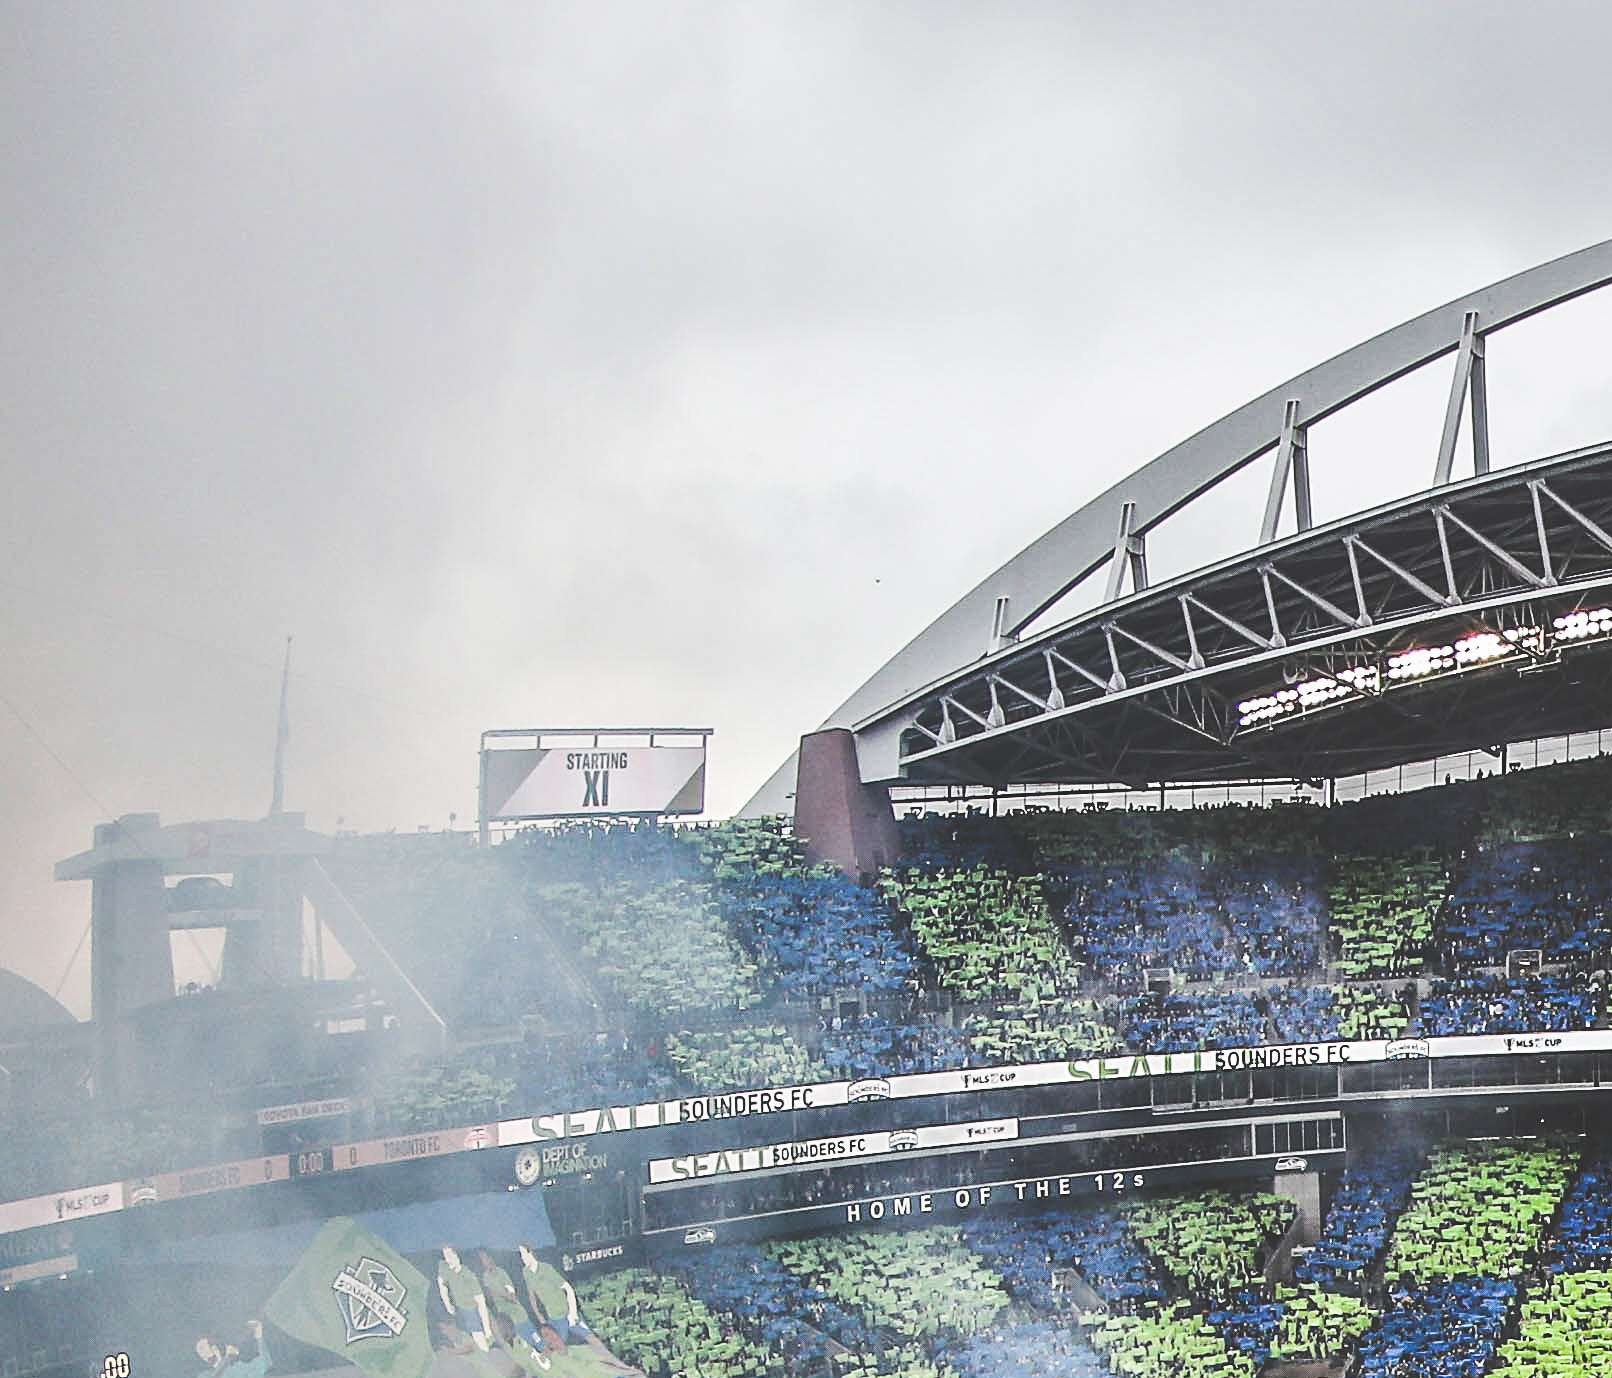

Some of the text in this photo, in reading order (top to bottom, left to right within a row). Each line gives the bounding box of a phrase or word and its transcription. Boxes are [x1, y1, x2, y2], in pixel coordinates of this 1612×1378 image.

[566, 752, 628, 771] STARTING
[583, 771, 608, 807] XI
[1516, 1038, 1562, 1049] MLS CUP
[1215, 1044, 1351, 1071] SOUNDERS FC
[972, 1073, 1016, 1084] MLS CUP
[680, 1087, 813, 1122] SOUNDERS FC
[543, 1142, 588, 1163] DEPT OF
[773, 1138, 866, 1163] SOUNDERS FC
[847, 1172, 1145, 1223] HOME OF THE 12s
[576, 1246, 624, 1264] STARBUCKS
